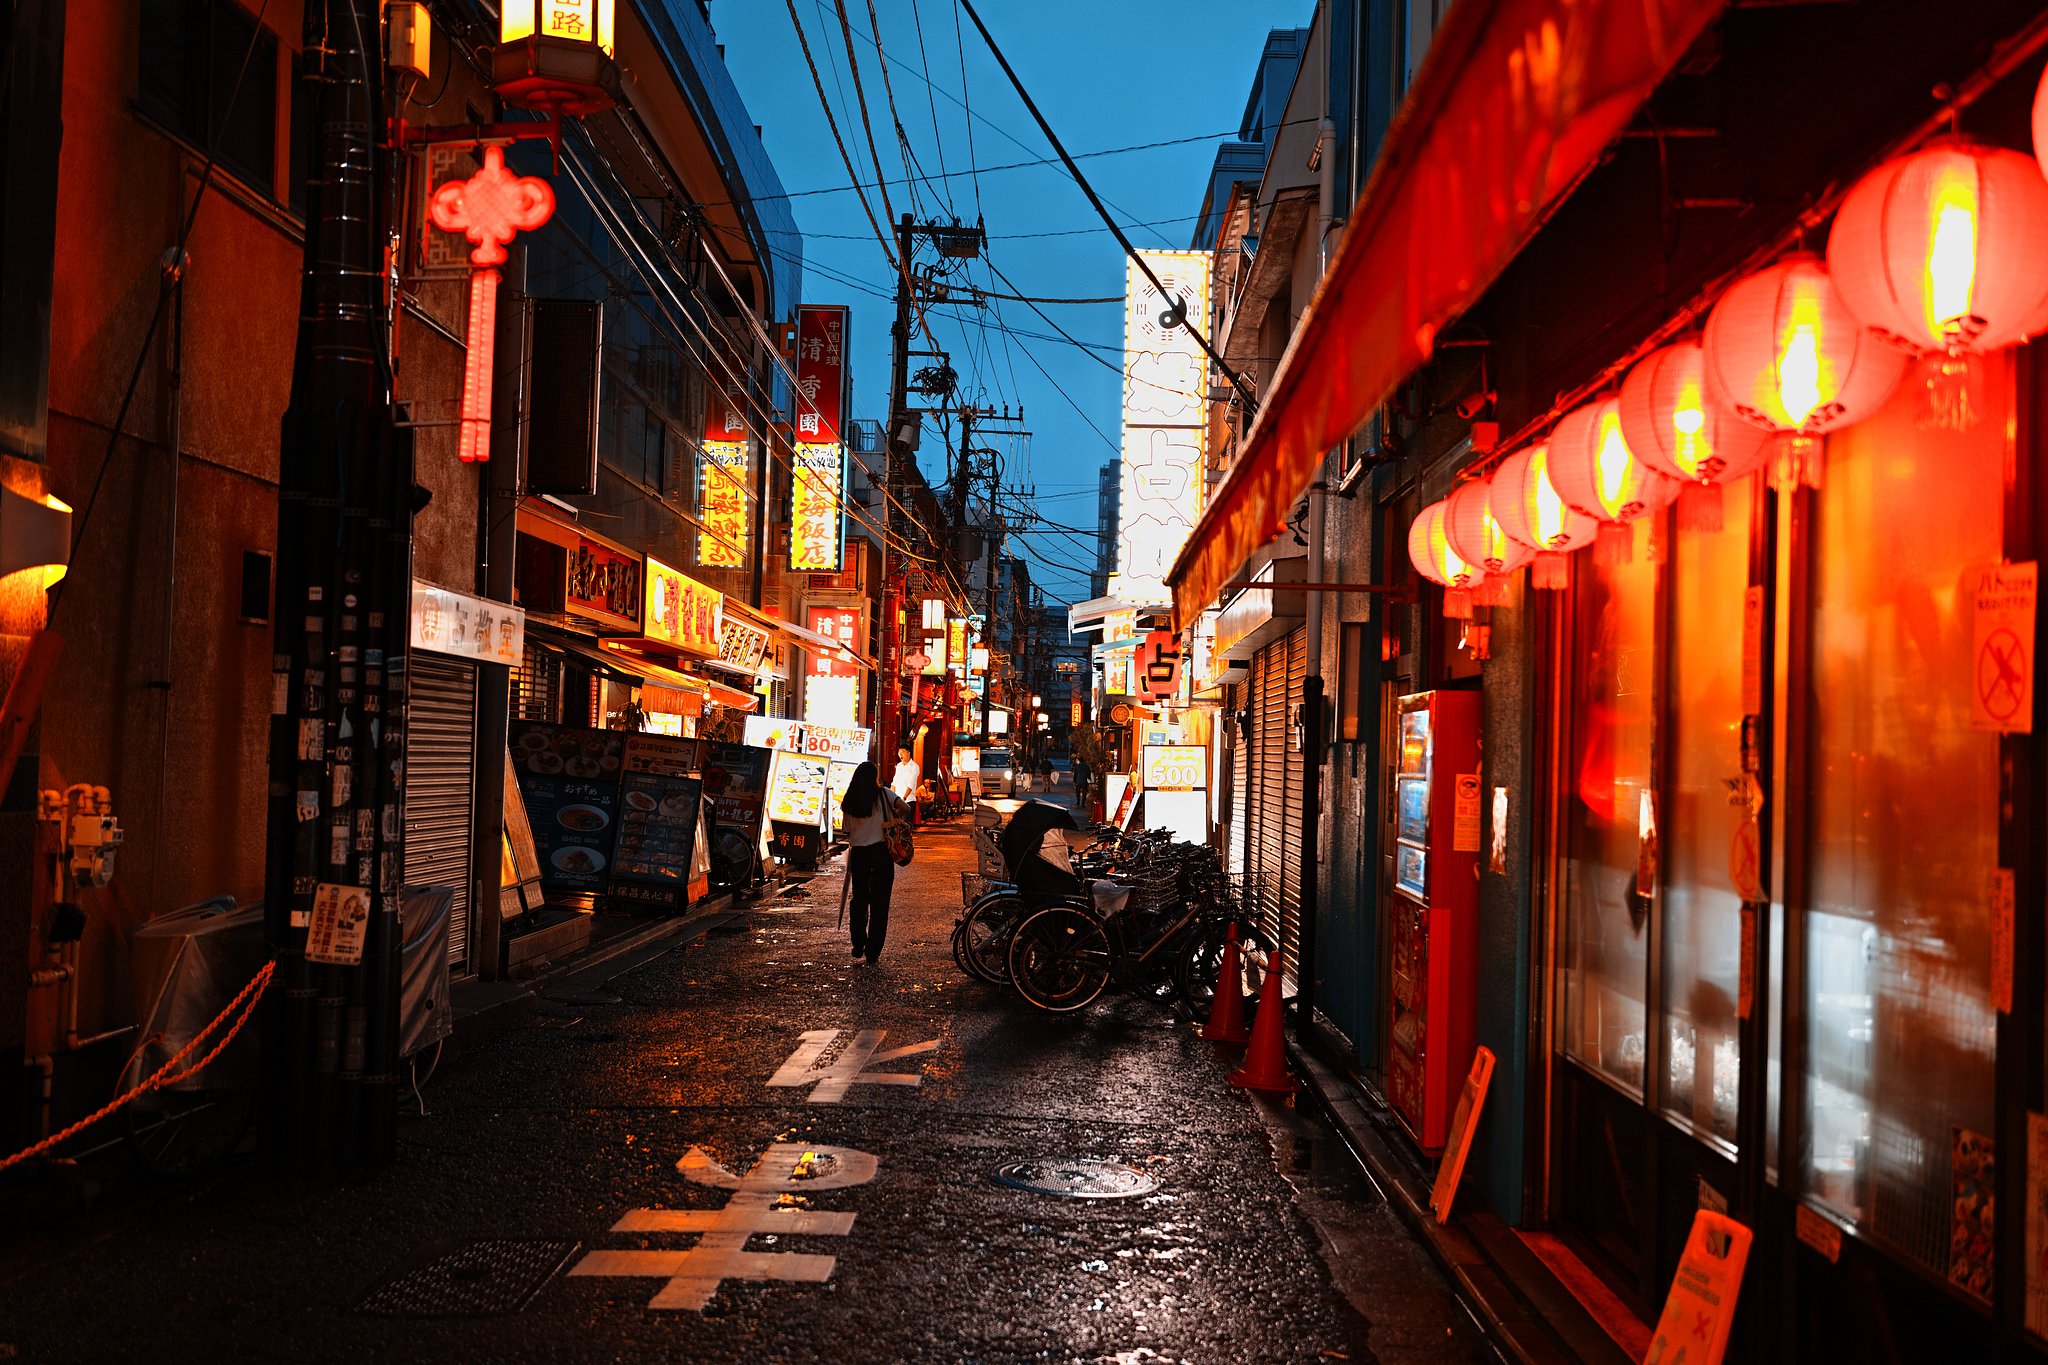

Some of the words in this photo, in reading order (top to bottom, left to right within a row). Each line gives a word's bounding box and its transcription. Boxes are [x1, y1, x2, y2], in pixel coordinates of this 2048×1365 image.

[552, 0, 584, 34] 路
[800, 337, 825, 435] 清香園
[1147, 643, 1180, 683] 占
[1151, 765, 1198, 786] 500
